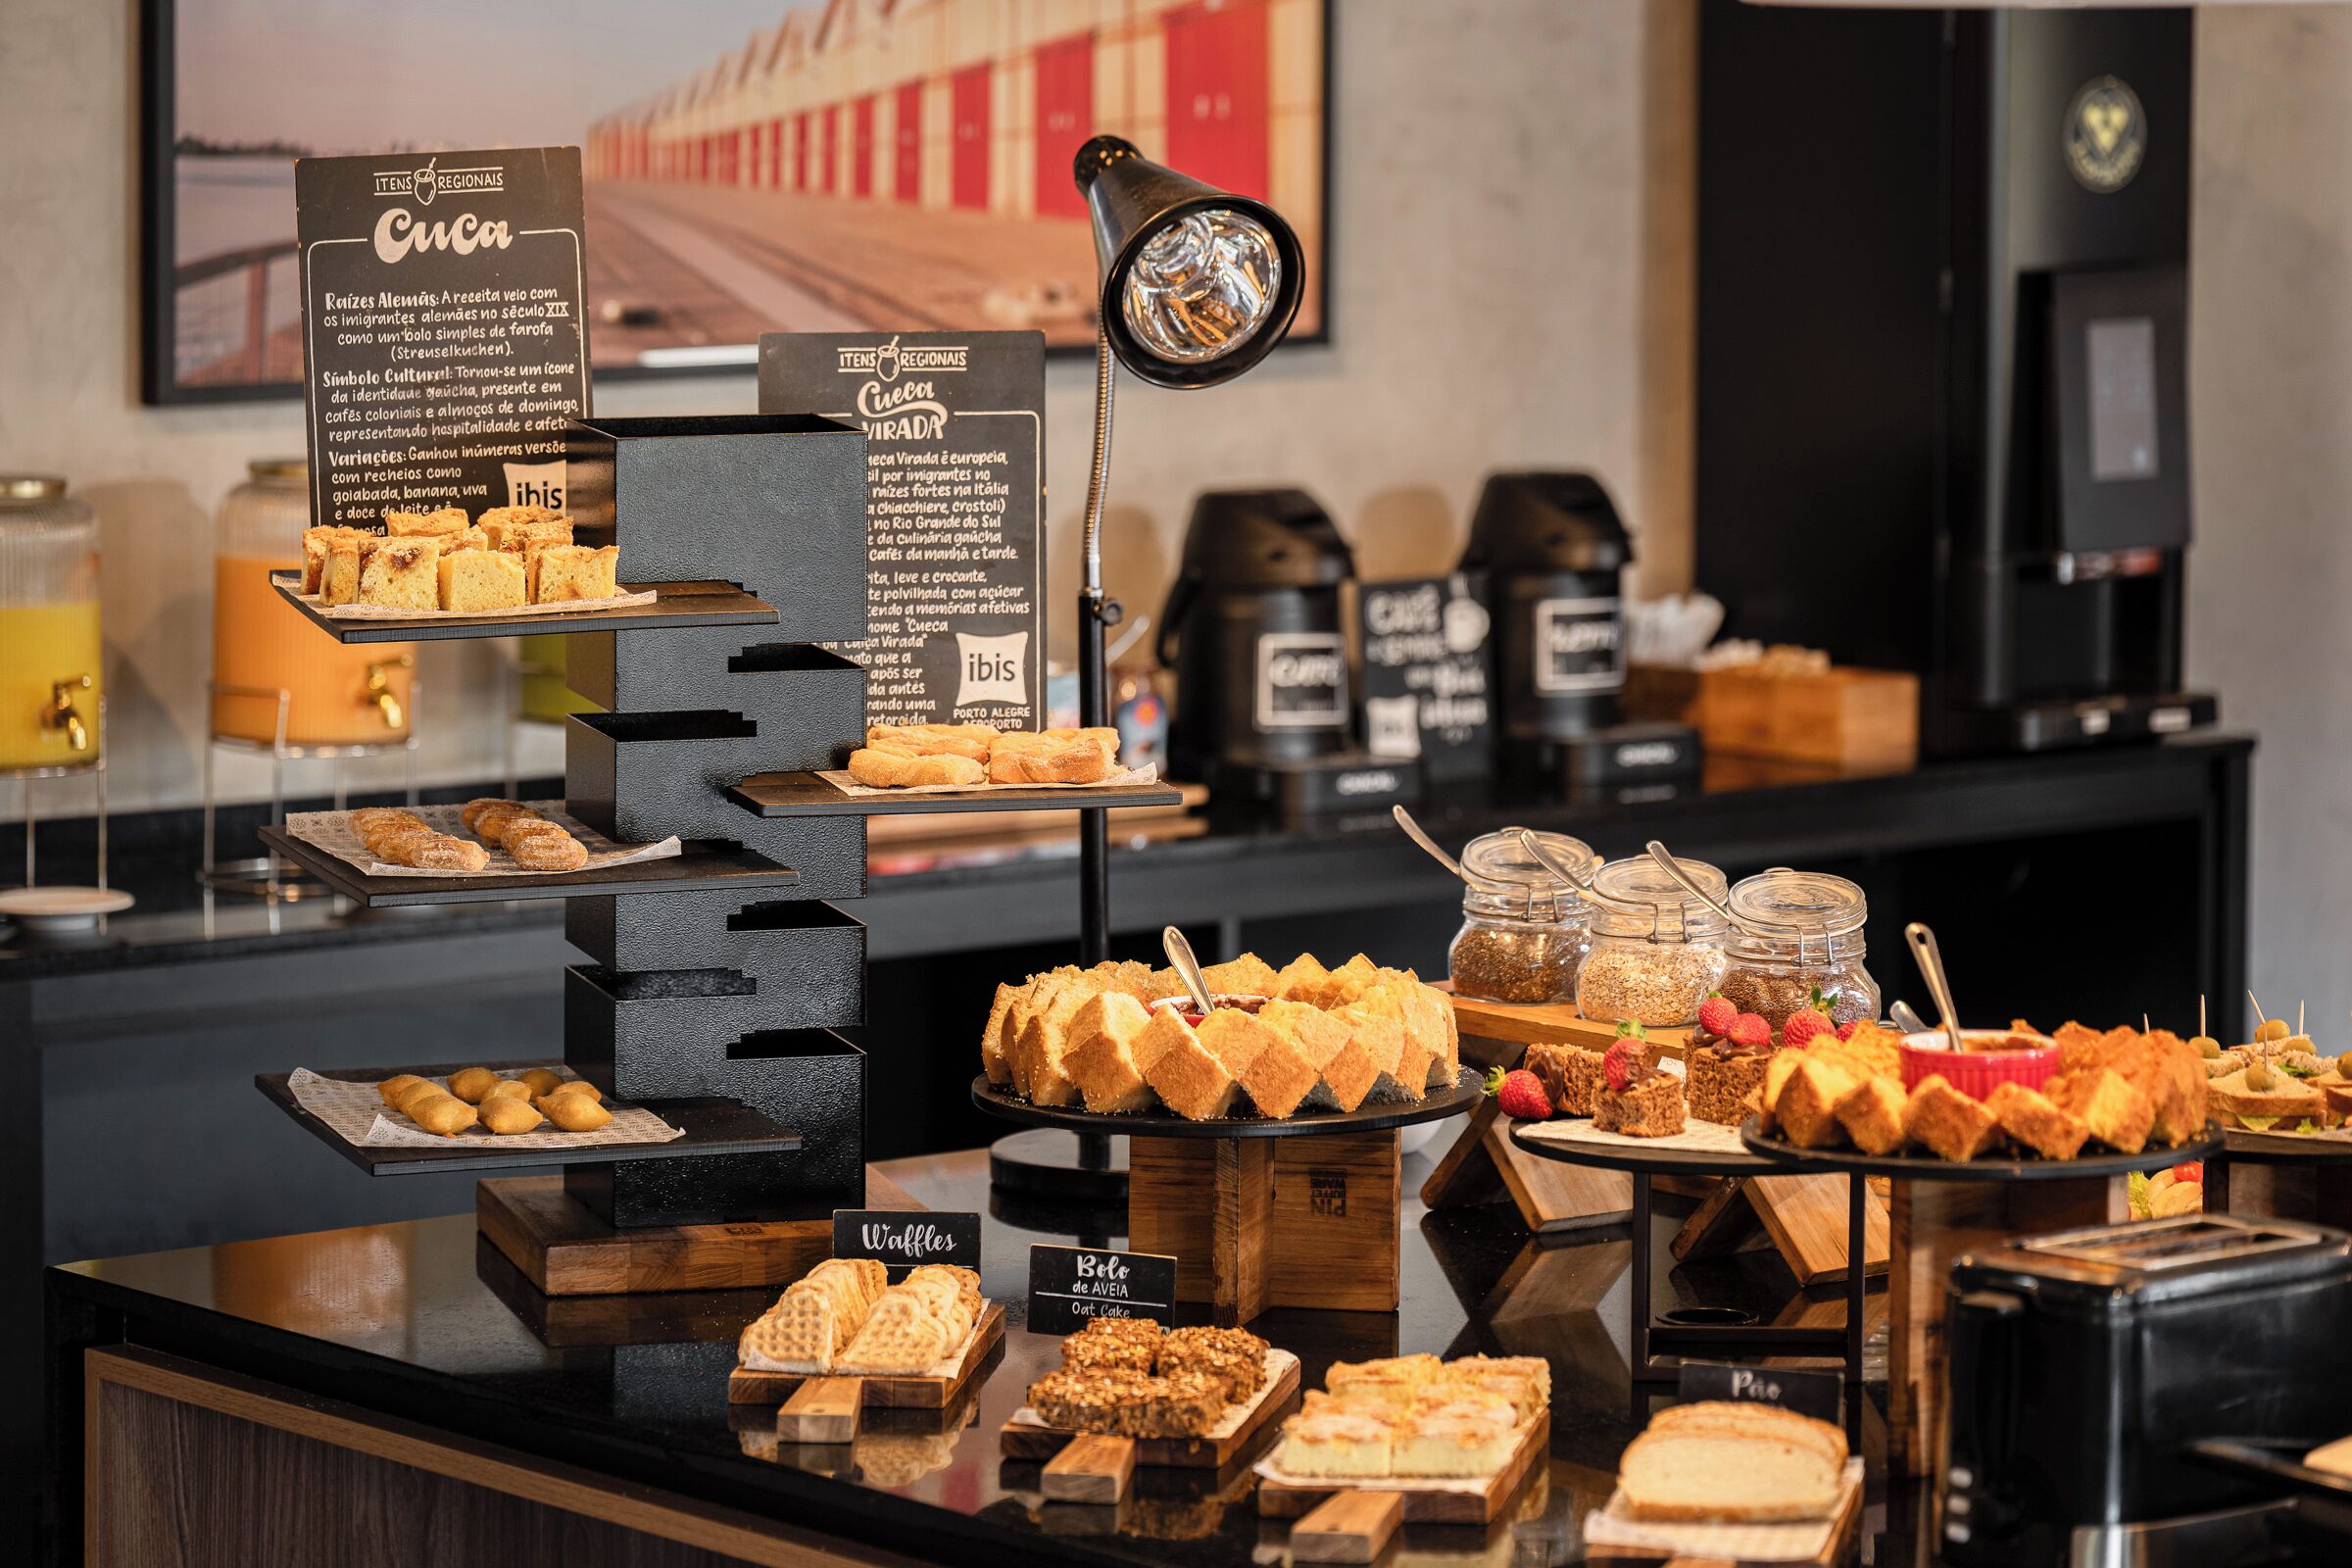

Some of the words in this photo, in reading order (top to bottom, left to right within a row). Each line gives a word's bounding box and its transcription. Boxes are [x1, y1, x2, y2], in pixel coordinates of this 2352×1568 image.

[375, 176, 412, 192] ITENS
[437, 172, 504, 189] REGIONAIS
[374, 207, 514, 264] Cuca
[325, 292, 374, 311] Raízes
[378, 291, 439, 309] Alemãs:
[441, 290, 451, 304] A
[453, 288, 501, 304] receita
[504, 289, 527, 302] veio
[529, 288, 558, 300] com
[323, 316, 338, 327] os
[341, 310, 416, 328] imigrantes
[421, 308, 478, 323] alemães
[480, 309, 498, 319] no
[501, 304, 545, 319] século
[545, 302, 569, 318] XIX
[337, 332, 373, 345] como
[377, 332, 400, 343] um
[405, 327, 431, 342] bolo
[435, 324, 486, 343] simples
[489, 323, 506, 338] de
[510, 321, 554, 336] farofa
[391, 341, 514, 363] (Streuselkuchen).
[839, 353, 876, 368] ITENS
[900, 351, 967, 368] REGIONAIS
[323, 370, 380, 388] Símbolo
[384, 366, 453, 384] Cultural:
[455, 366, 516, 378] Tornou-se
[519, 366, 541, 375] um
[544, 362, 574, 375] ícone
[331, 389, 349, 404] da
[352, 386, 421, 402] identidade
[425, 384, 478, 400] gaúcha,
[482, 380, 536, 398] presente
[541, 381, 562, 393] em
[857, 380, 939, 419] Cueca
[325, 408, 361, 423] cafés
[365, 406, 421, 421] coloniais
[425, 408, 434, 417] e
[438, 402, 494, 417] almoços
[498, 399, 514, 414] de
[518, 398, 579, 414] domingo,
[329, 423, 427, 443] representando
[431, 417, 520, 439] hospitalidade
[524, 419, 533, 429] e
[862, 415, 944, 440] VIRADA
[328, 449, 407, 466] Variações:
[408, 445, 458, 461] Ganhou
[462, 443, 523, 458] inúmeras
[896, 451, 939, 466] Virada
[941, 450, 949, 465] é
[950, 450, 1009, 466] europeia,
[331, 472, 361, 484] com
[365, 467, 421, 482] recheios
[426, 466, 462, 479] como
[882, 470, 903, 485] por
[906, 466, 972, 485] imigrantes
[975, 469, 991, 481] no
[333, 485, 401, 506] goiabada,
[404, 485, 461, 499] banana,
[463, 484, 488, 496] uva
[516, 480, 563, 510] ibis
[872, 484, 909, 498] raízes
[912, 483, 952, 497] fortes
[953, 485, 972, 497] na
[974, 481, 1009, 496] Itália
[335, 510, 343, 520] e
[347, 506, 375, 519] doce
[952, 497, 1005, 514] crostoli)
[873, 519, 890, 530] no
[892, 516, 912, 530] Rio
[915, 514, 960, 529] Grande
[962, 514, 979, 528] do
[981, 514, 1002, 528] Sul
[876, 533, 894, 545] da
[954, 530, 1003, 547] gaúcha
[906, 546, 923, 561] da
[923, 547, 969, 563] manhã
[972, 549, 980, 561] e
[981, 545, 1019, 560] tarde.
[894, 571, 918, 584] leve
[921, 572, 930, 584] e
[932, 569, 988, 584] crocante,
[883, 586, 948, 603] polvilhada
[951, 588, 976, 600] com
[978, 585, 1024, 600] açúcar
[905, 605, 913, 615] a
[915, 602, 977, 615] memórias
[978, 601, 1030, 614] afetivas
[874, 652, 899, 666] que
[902, 652, 911, 663] a
[968, 653, 1016, 682] ibis
[902, 667, 923, 679] ser
[905, 699, 936, 710] uma
[953, 708, 988, 719] PORTO
[991, 706, 1031, 717] ALEGRE
[861, 1223, 956, 1258] Waffles
[1076, 1254, 1131, 1280] Bolo
[1072, 1280, 1089, 1294] de
[1092, 1281, 1129, 1298] AVEIA
[1072, 1301, 1096, 1316] Oat
[1101, 1303, 1131, 1319] Cake
